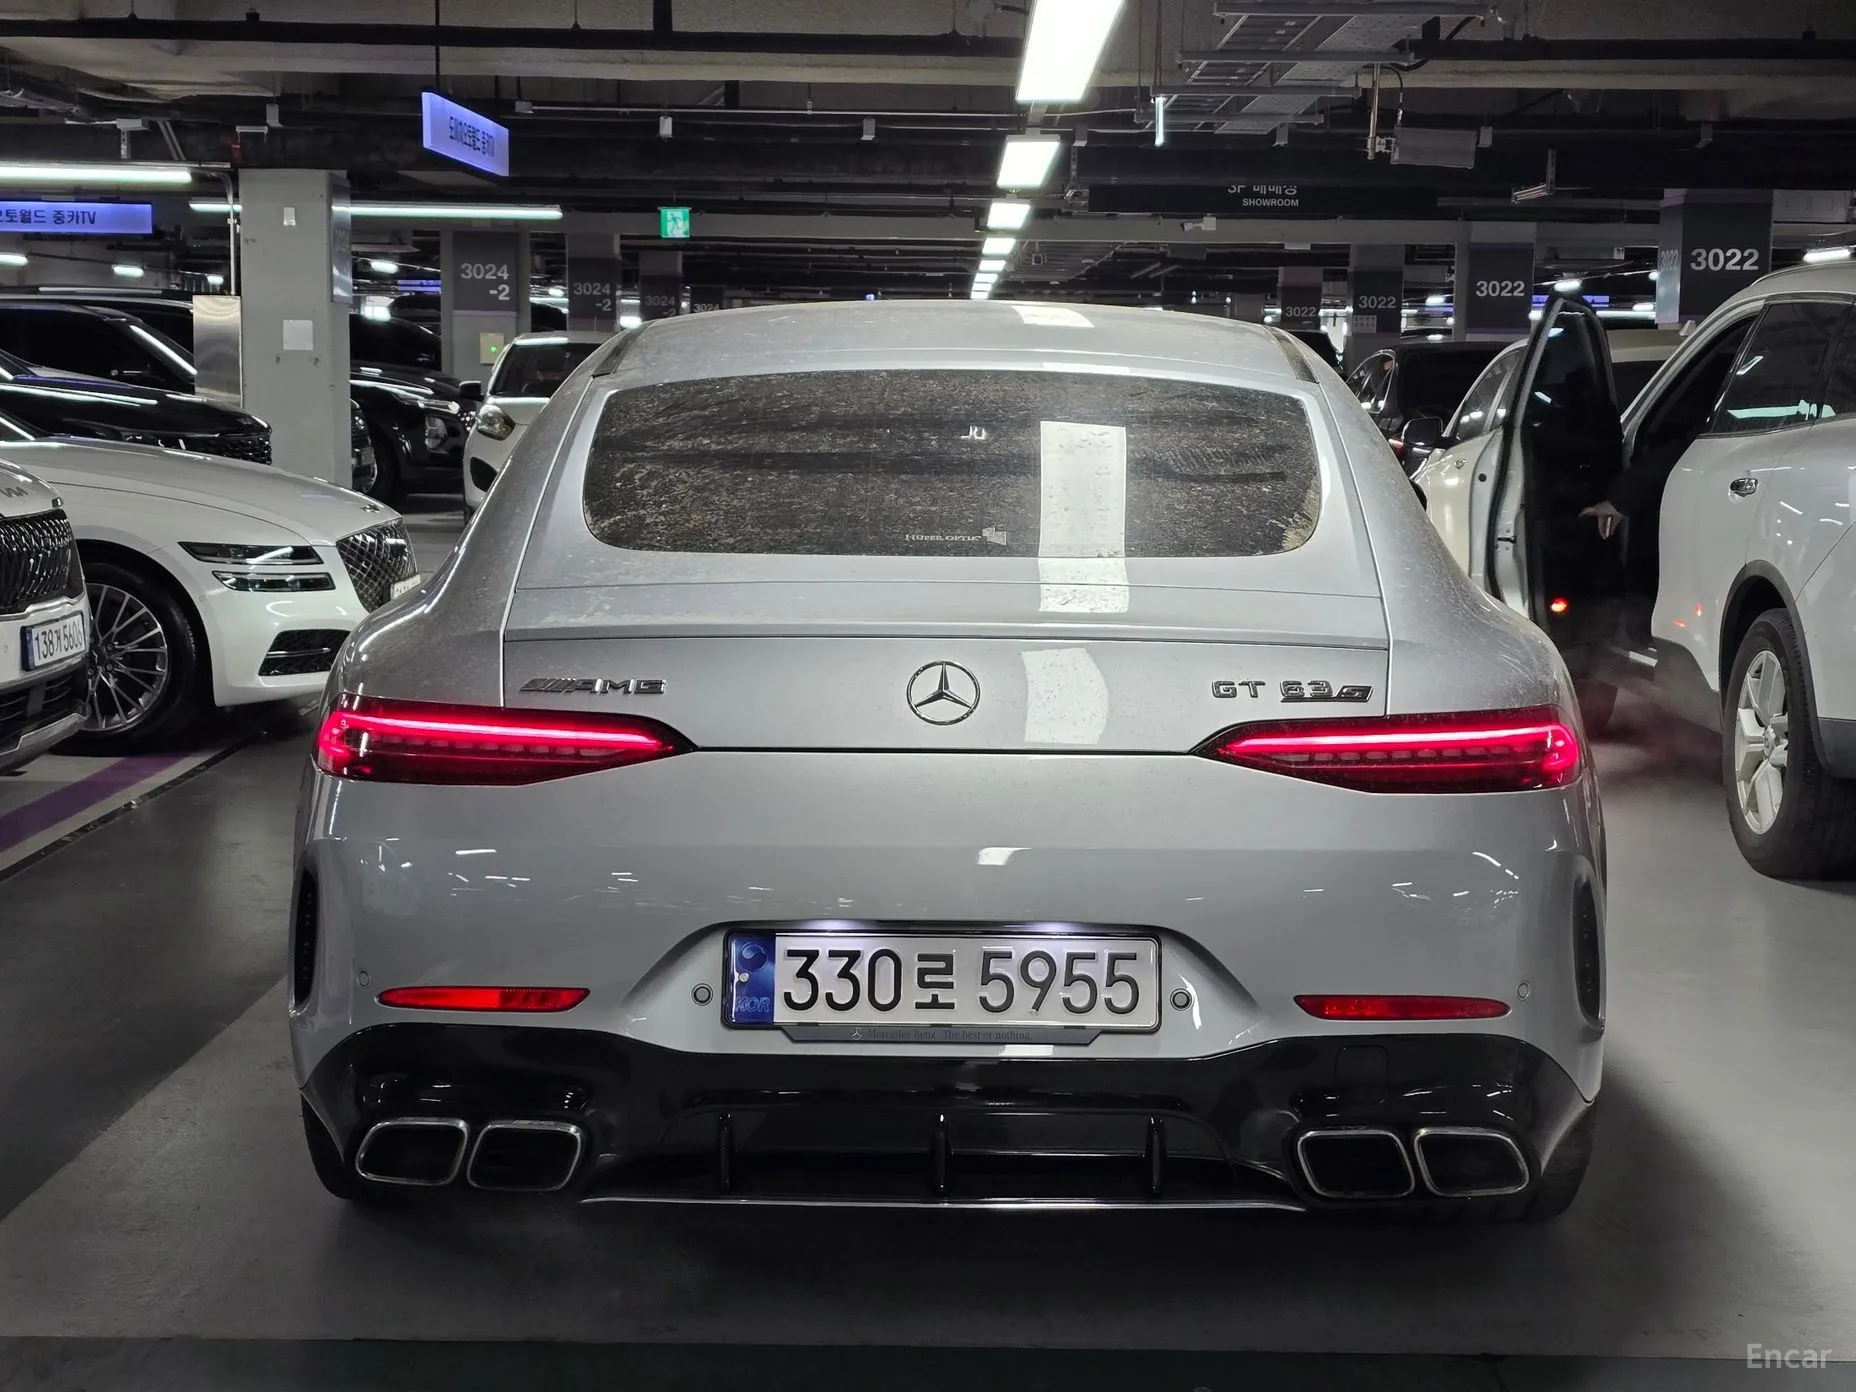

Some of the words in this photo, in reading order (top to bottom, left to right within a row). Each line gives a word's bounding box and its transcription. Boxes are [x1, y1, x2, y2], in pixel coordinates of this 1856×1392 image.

[1242, 198, 1299, 207] SHOWROOM
[52, 210, 97, 225] 중카TV
[1690, 248, 1760, 271] 3022
[460, 263, 510, 280] 3024
[489, 284, 511, 301] -2
[573, 282, 611, 296] 3024
[1475, 280, 1525, 297] 3022
[595, 299, 612, 312] -2
[645, 295, 676, 307] 3024
[1358, 295, 1397, 309] 3022
[1284, 306, 1317, 318] 3022
[1211, 680, 1266, 699] GT
[979, 950, 1140, 1015] 5955
[735, 996, 770, 1013] KOR
[943, 1029, 959, 1039] The
[962, 1029, 982, 1039] best
